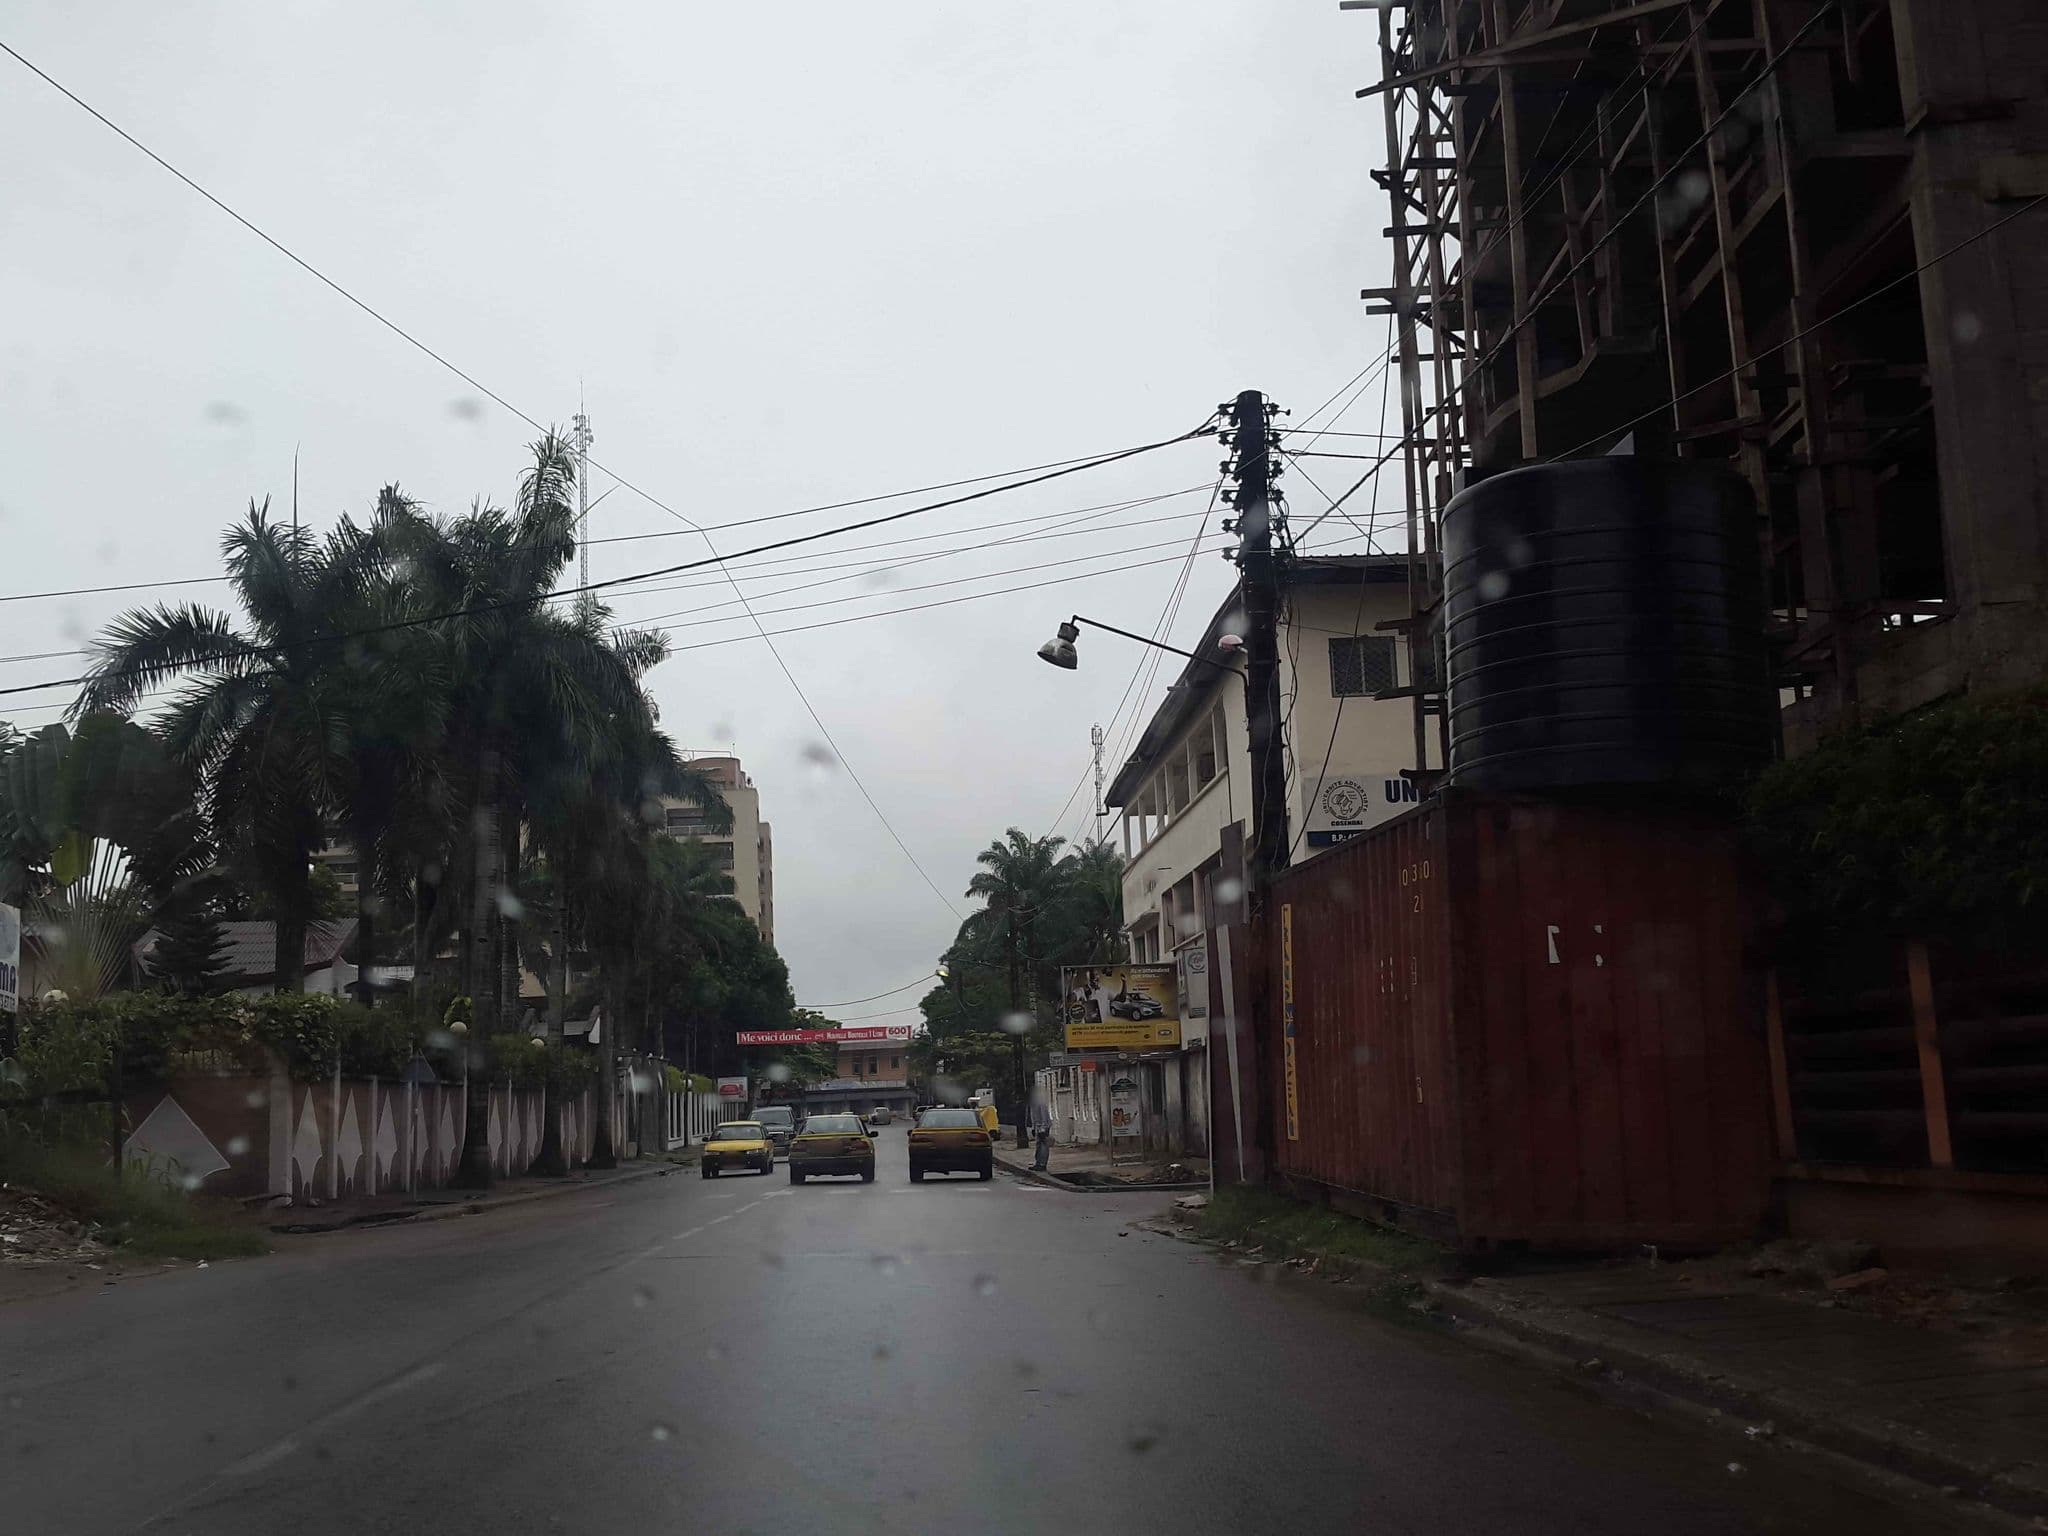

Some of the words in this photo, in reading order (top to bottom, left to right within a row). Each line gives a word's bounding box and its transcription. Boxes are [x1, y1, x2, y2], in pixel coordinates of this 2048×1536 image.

[741, 1033, 756, 1043] Me
[757, 1032, 778, 1042] voici
[779, 1032, 802, 1041] donc
[888, 1027, 907, 1035] 600
